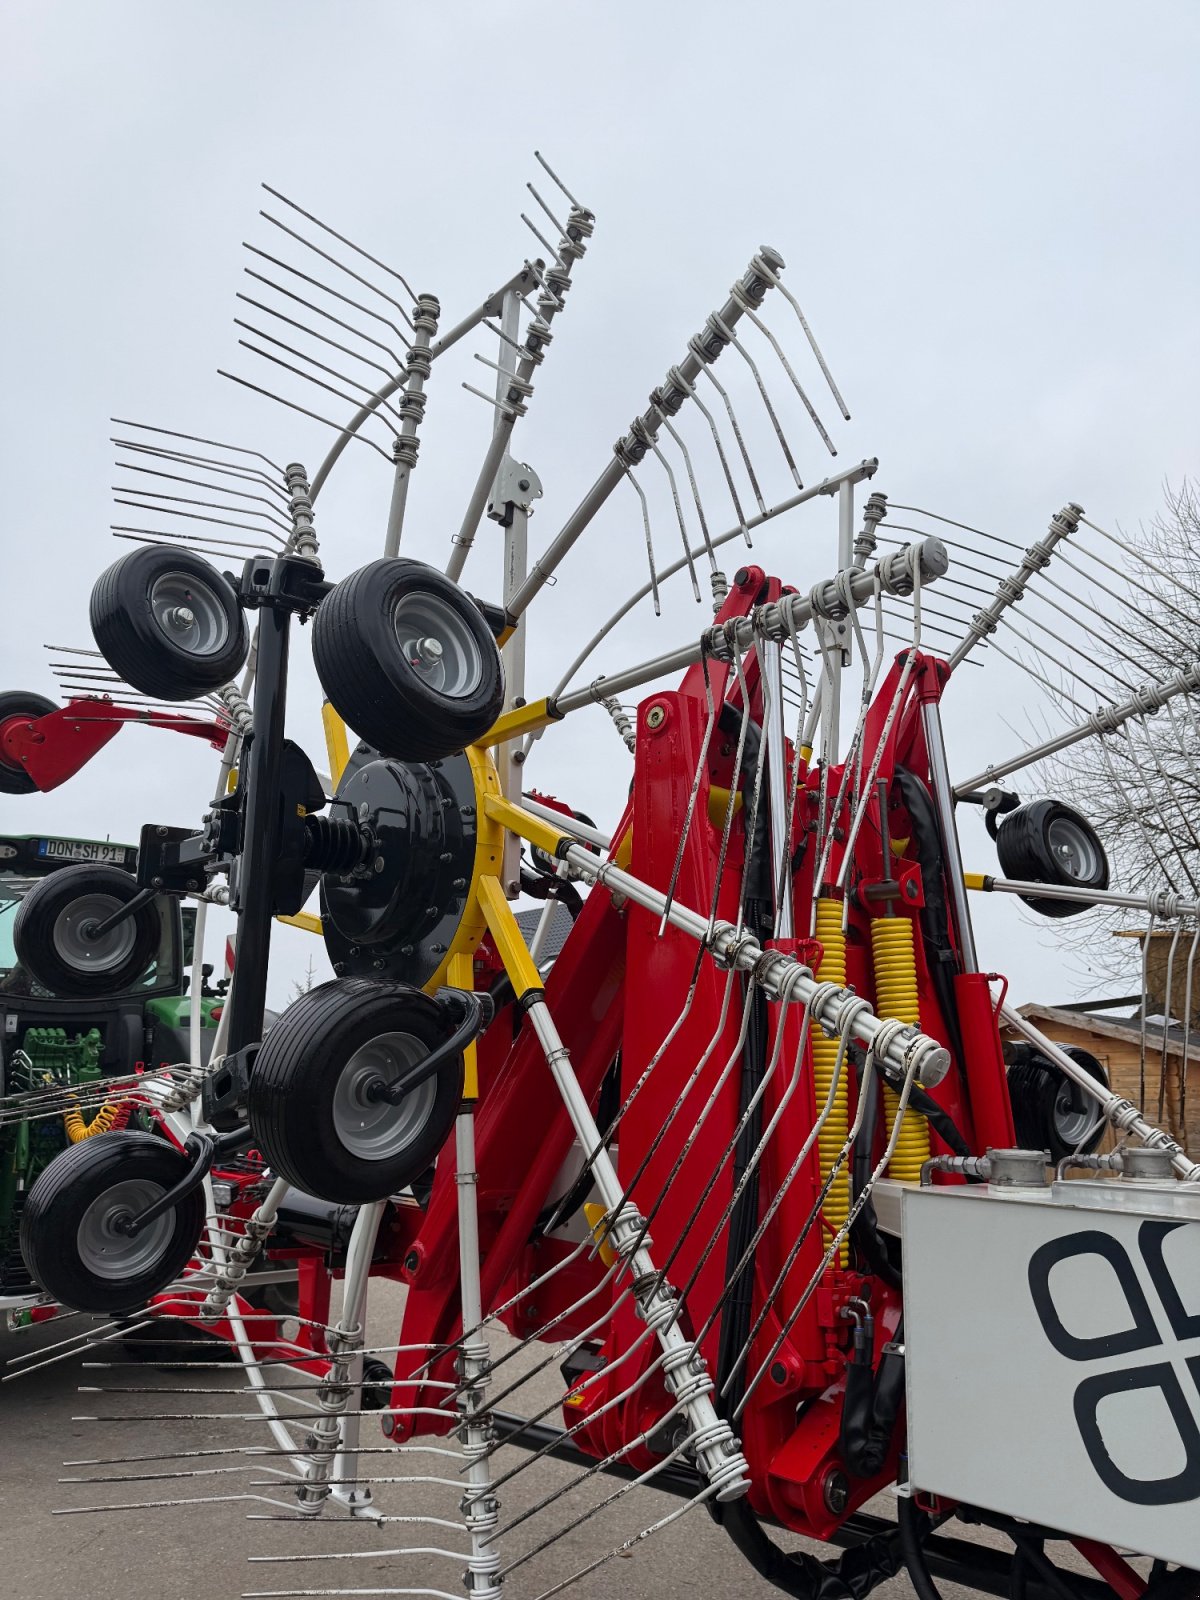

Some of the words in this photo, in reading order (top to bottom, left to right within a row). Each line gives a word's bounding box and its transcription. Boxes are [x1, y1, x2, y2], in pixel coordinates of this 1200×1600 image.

[48, 841, 73, 857] DON
[82, 844, 99, 859] SH
[102, 847, 117, 861] 91
